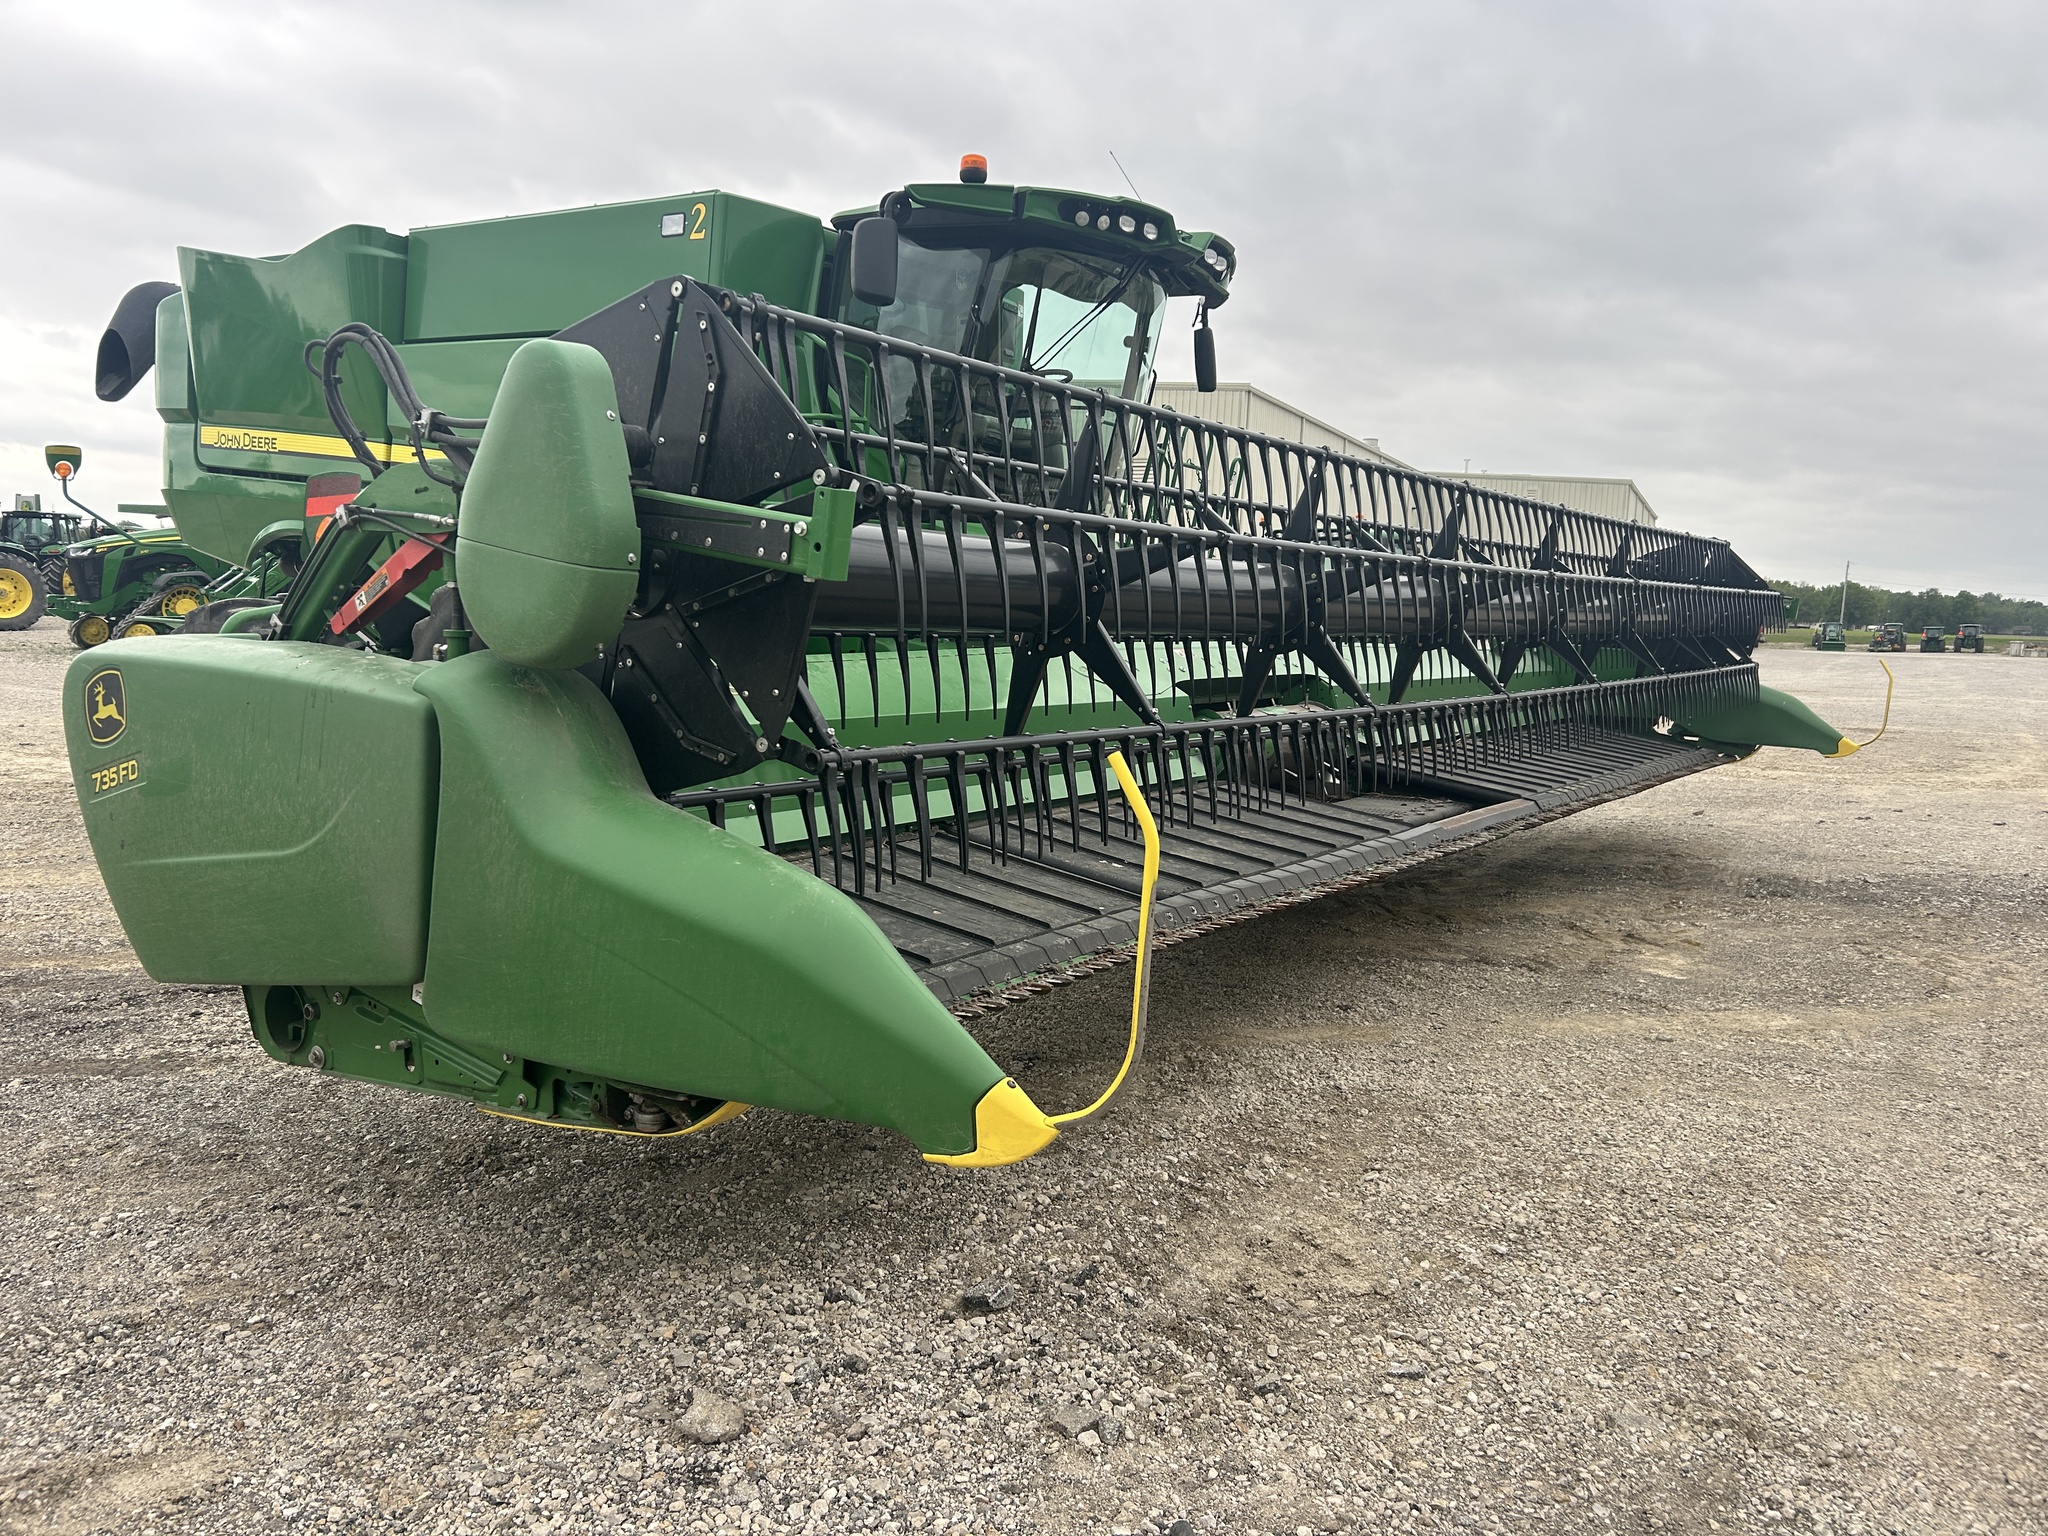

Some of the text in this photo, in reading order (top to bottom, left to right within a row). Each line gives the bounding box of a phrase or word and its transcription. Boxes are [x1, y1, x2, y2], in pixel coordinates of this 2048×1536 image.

[689, 202, 707, 240] 2
[214, 430, 277, 450] JOHN DEERE
[91, 760, 138, 793] 735FD
